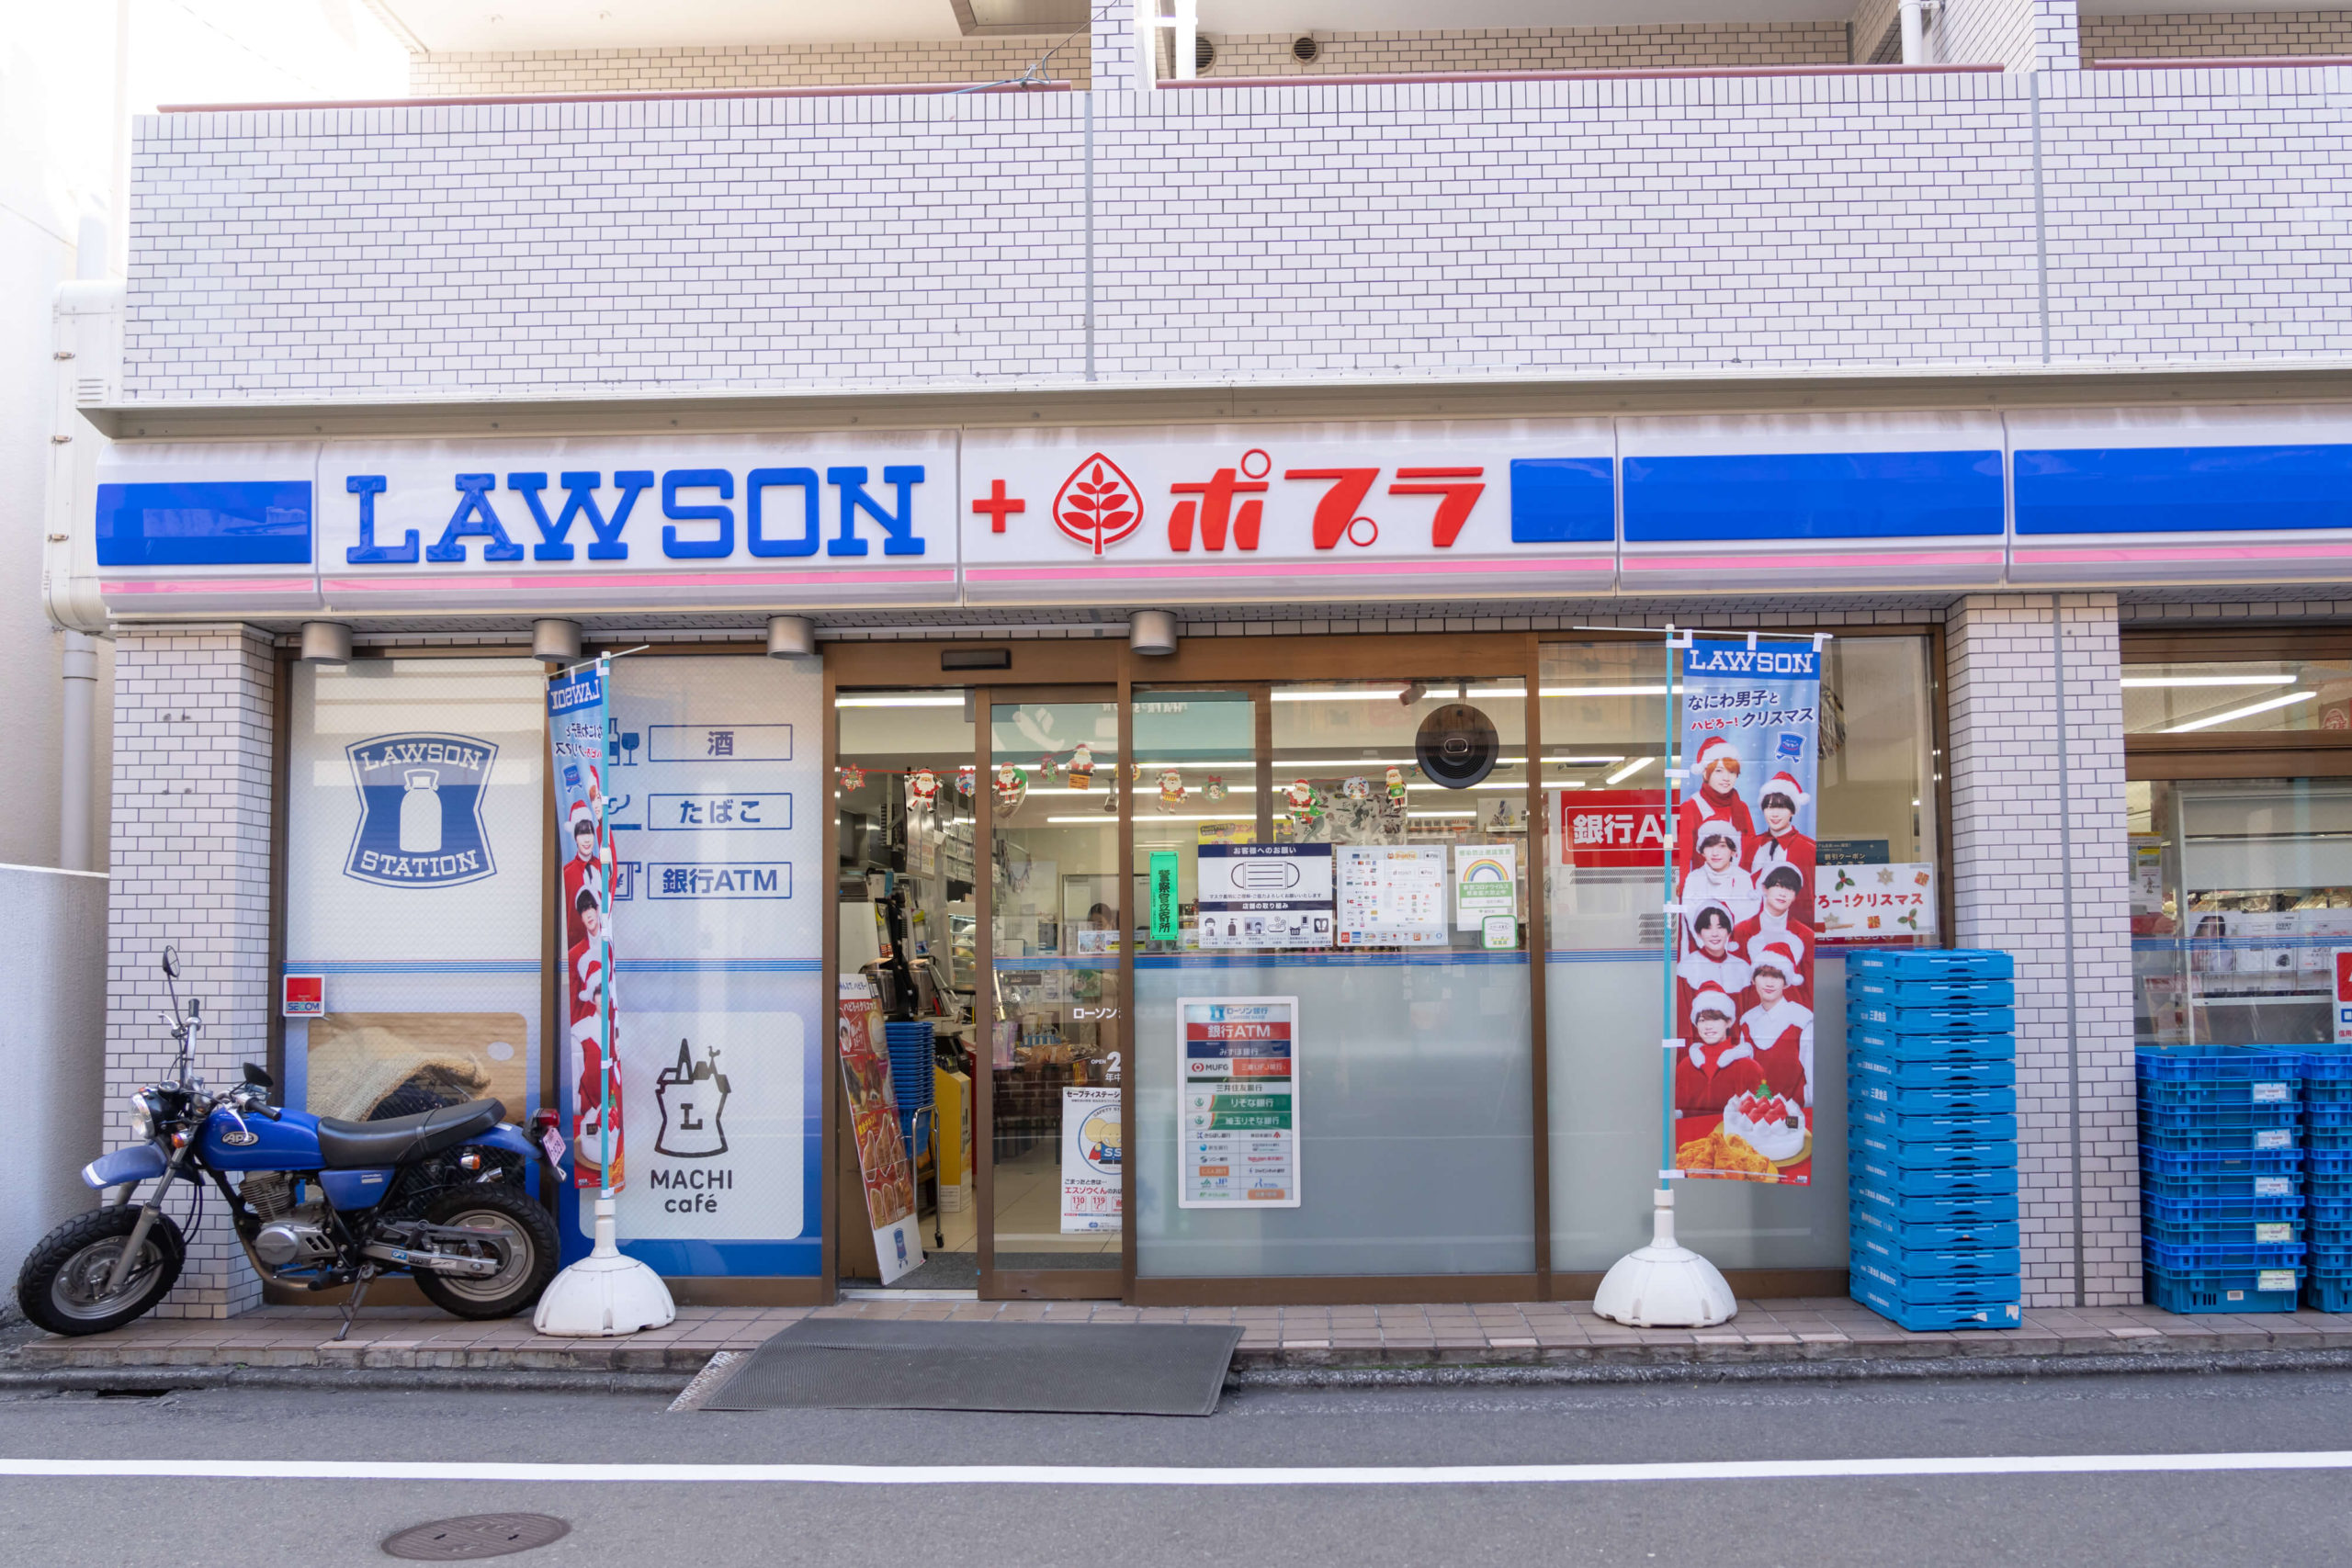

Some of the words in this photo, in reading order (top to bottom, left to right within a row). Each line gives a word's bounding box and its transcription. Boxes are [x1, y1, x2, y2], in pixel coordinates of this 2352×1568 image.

[346, 465, 925, 564] LAWSON
[1168, 448, 1486, 551] ポプラ
[1690, 649, 1814, 673] LAWSON
[1688, 690, 1779, 710] なにわ男子と
[1742, 707, 1814, 728] クリスマス
[707, 731, 734, 756] 酒
[360, 743, 482, 772] LAWSON
[680, 799, 761, 824] たばこ
[360, 850, 480, 876] STATION
[662, 868, 777, 894] 銀行ATM
[1815, 893, 1924, 908] ろー!クリスマス
[288, 1002, 320, 1010] SECOM
[1073, 1008, 1121, 1020] ローソン
[1207, 1024, 1271, 1038] 銀行ATM
[1219, 1048, 1259, 1056] みずほ銀行
[1216, 1084, 1262, 1092] 三井住友銀行
[1231, 1099, 1273, 1108] りそな銀行
[680, 1103, 703, 1130] L
[1225, 1117, 1280, 1125] 埼玉りそな銀行
[650, 1169, 732, 1190] MACHI
[664, 1193, 718, 1213] café
